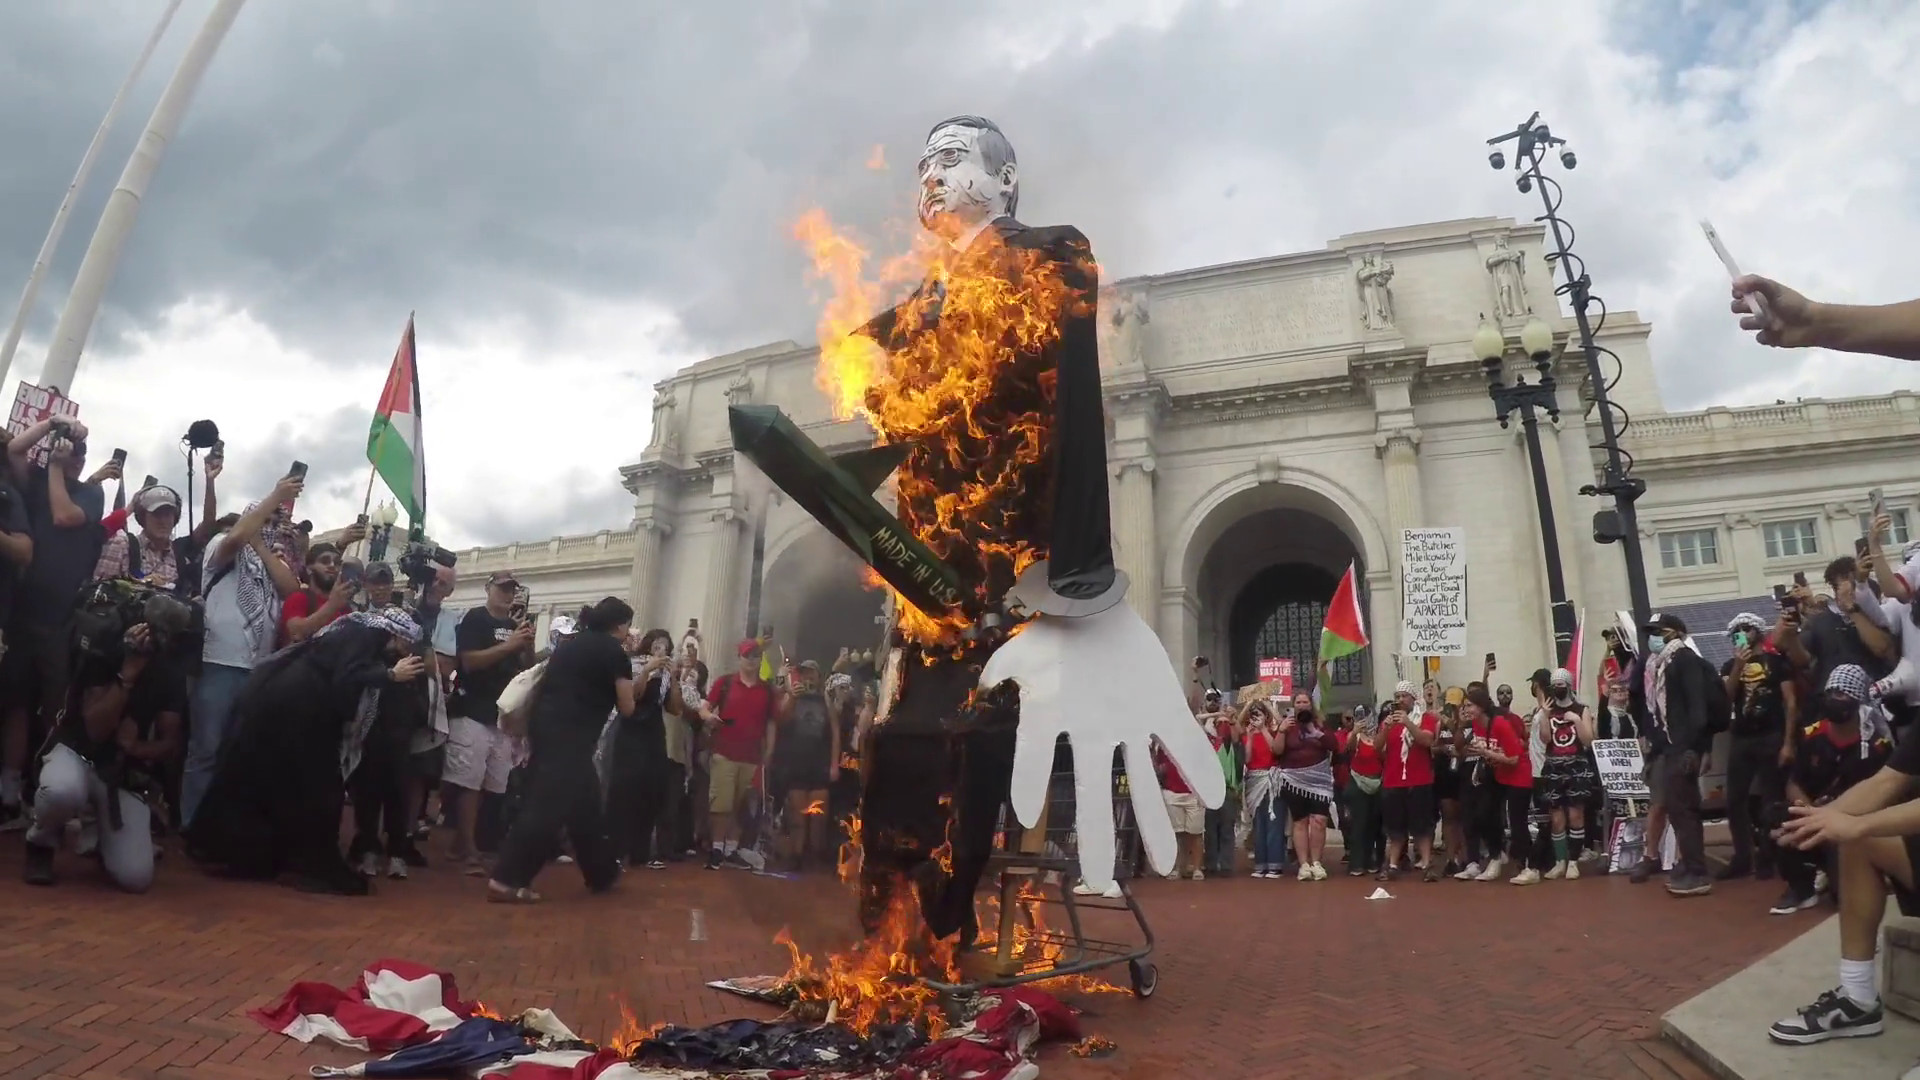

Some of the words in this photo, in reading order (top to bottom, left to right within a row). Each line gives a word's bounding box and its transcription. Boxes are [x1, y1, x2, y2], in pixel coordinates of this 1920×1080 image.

[17, 383, 49, 410] END
[1404, 529, 1451, 542] Benjamin
[1404, 542, 1420, 551] The
[1421, 541, 1456, 551] Butcher
[871, 526, 917, 568] MADE
[913, 563, 933, 582] IN
[1410, 563, 1428, 573] Face
[1429, 562, 1448, 572] Your
[1408, 583, 1421, 593] UN
[1440, 582, 1460, 592] Found
[1406, 593, 1429, 605] Israel
[1449, 592, 1460, 603] of
[1438, 617, 1465, 629] Genocide
[1416, 629, 1448, 640] AIPAC
[1408, 640, 1431, 653] Owns
[1431, 639, 1462, 653] Congress
[1595, 741, 1638, 749] RESISTANCE
[1597, 750, 1606, 758] IS
[1606, 749, 1640, 758] JUSTIFIED
[1610, 758, 1632, 766] WHEN
[1602, 772, 1630, 781] PEOPLE
[1608, 822, 1625, 872] WANTED
